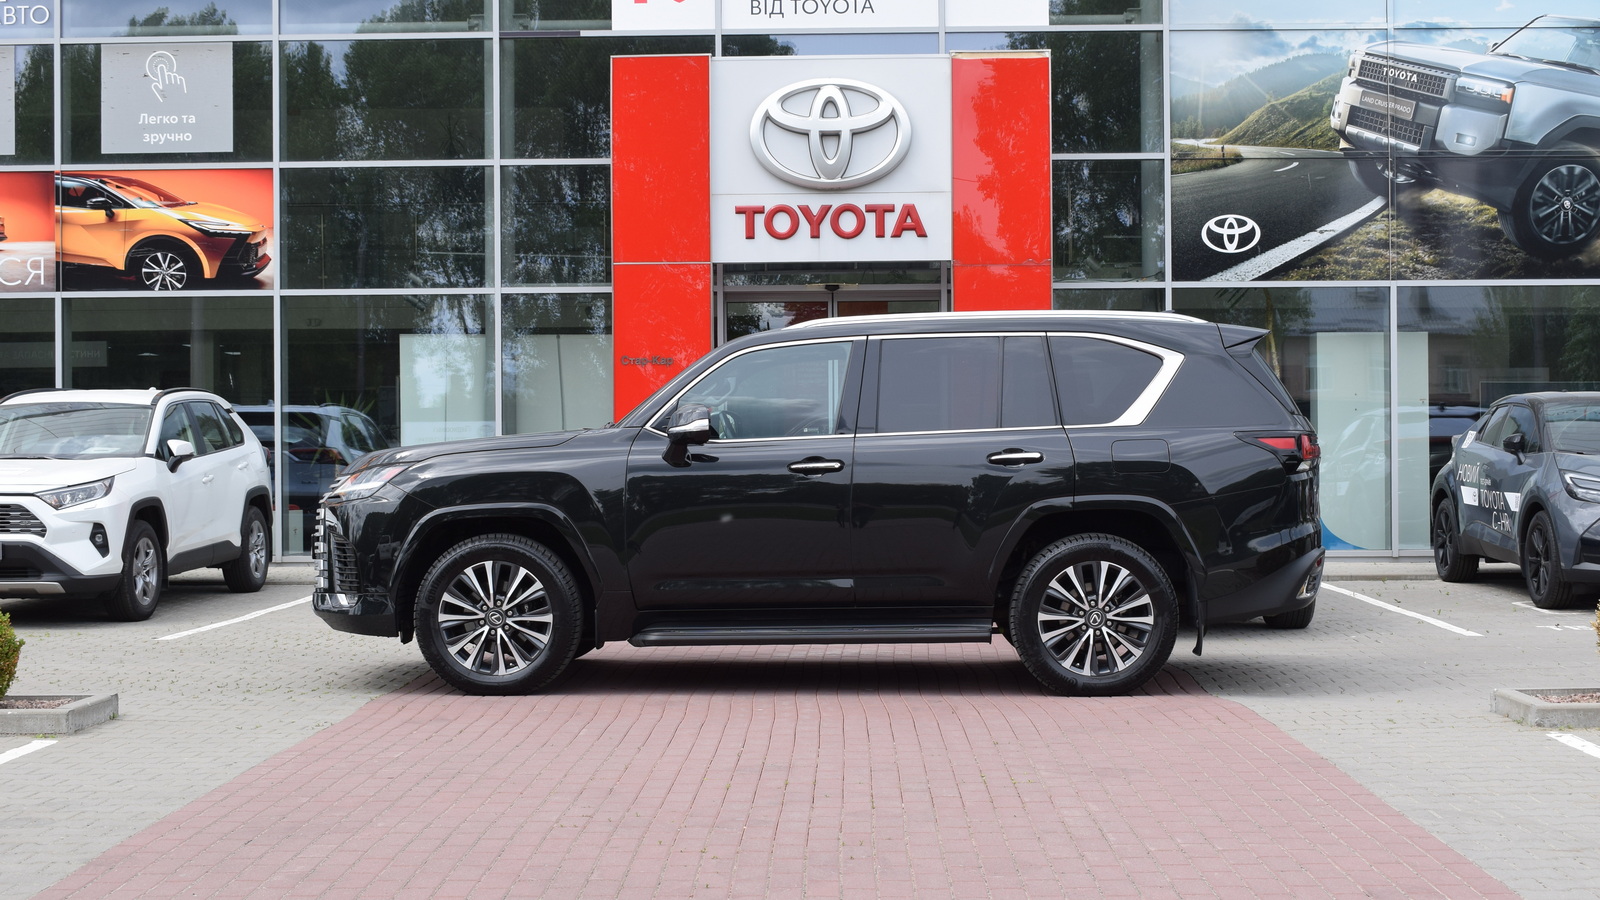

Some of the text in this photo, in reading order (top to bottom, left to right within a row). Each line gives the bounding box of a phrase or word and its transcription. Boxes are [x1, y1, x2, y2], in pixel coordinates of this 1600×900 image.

[0, 5, 50, 25] ВТО
[750, 0, 875, 18] ВІД TOYOTA
[1383, 67, 1418, 83] TOYOTA
[1361, 96, 1374, 104] LAND
[1375, 99, 1395, 108] CRUISER
[138, 113, 196, 124] Легко та
[142, 132, 193, 145] зручно
[734, 203, 928, 240] TOYOTA
[621, 355, 674, 367] Стар-Кар
[1456, 462, 1480, 483] НОВИЙ
[1480, 489, 1505, 510] TOYOTA
[1492, 511, 1512, 532] C-HR
